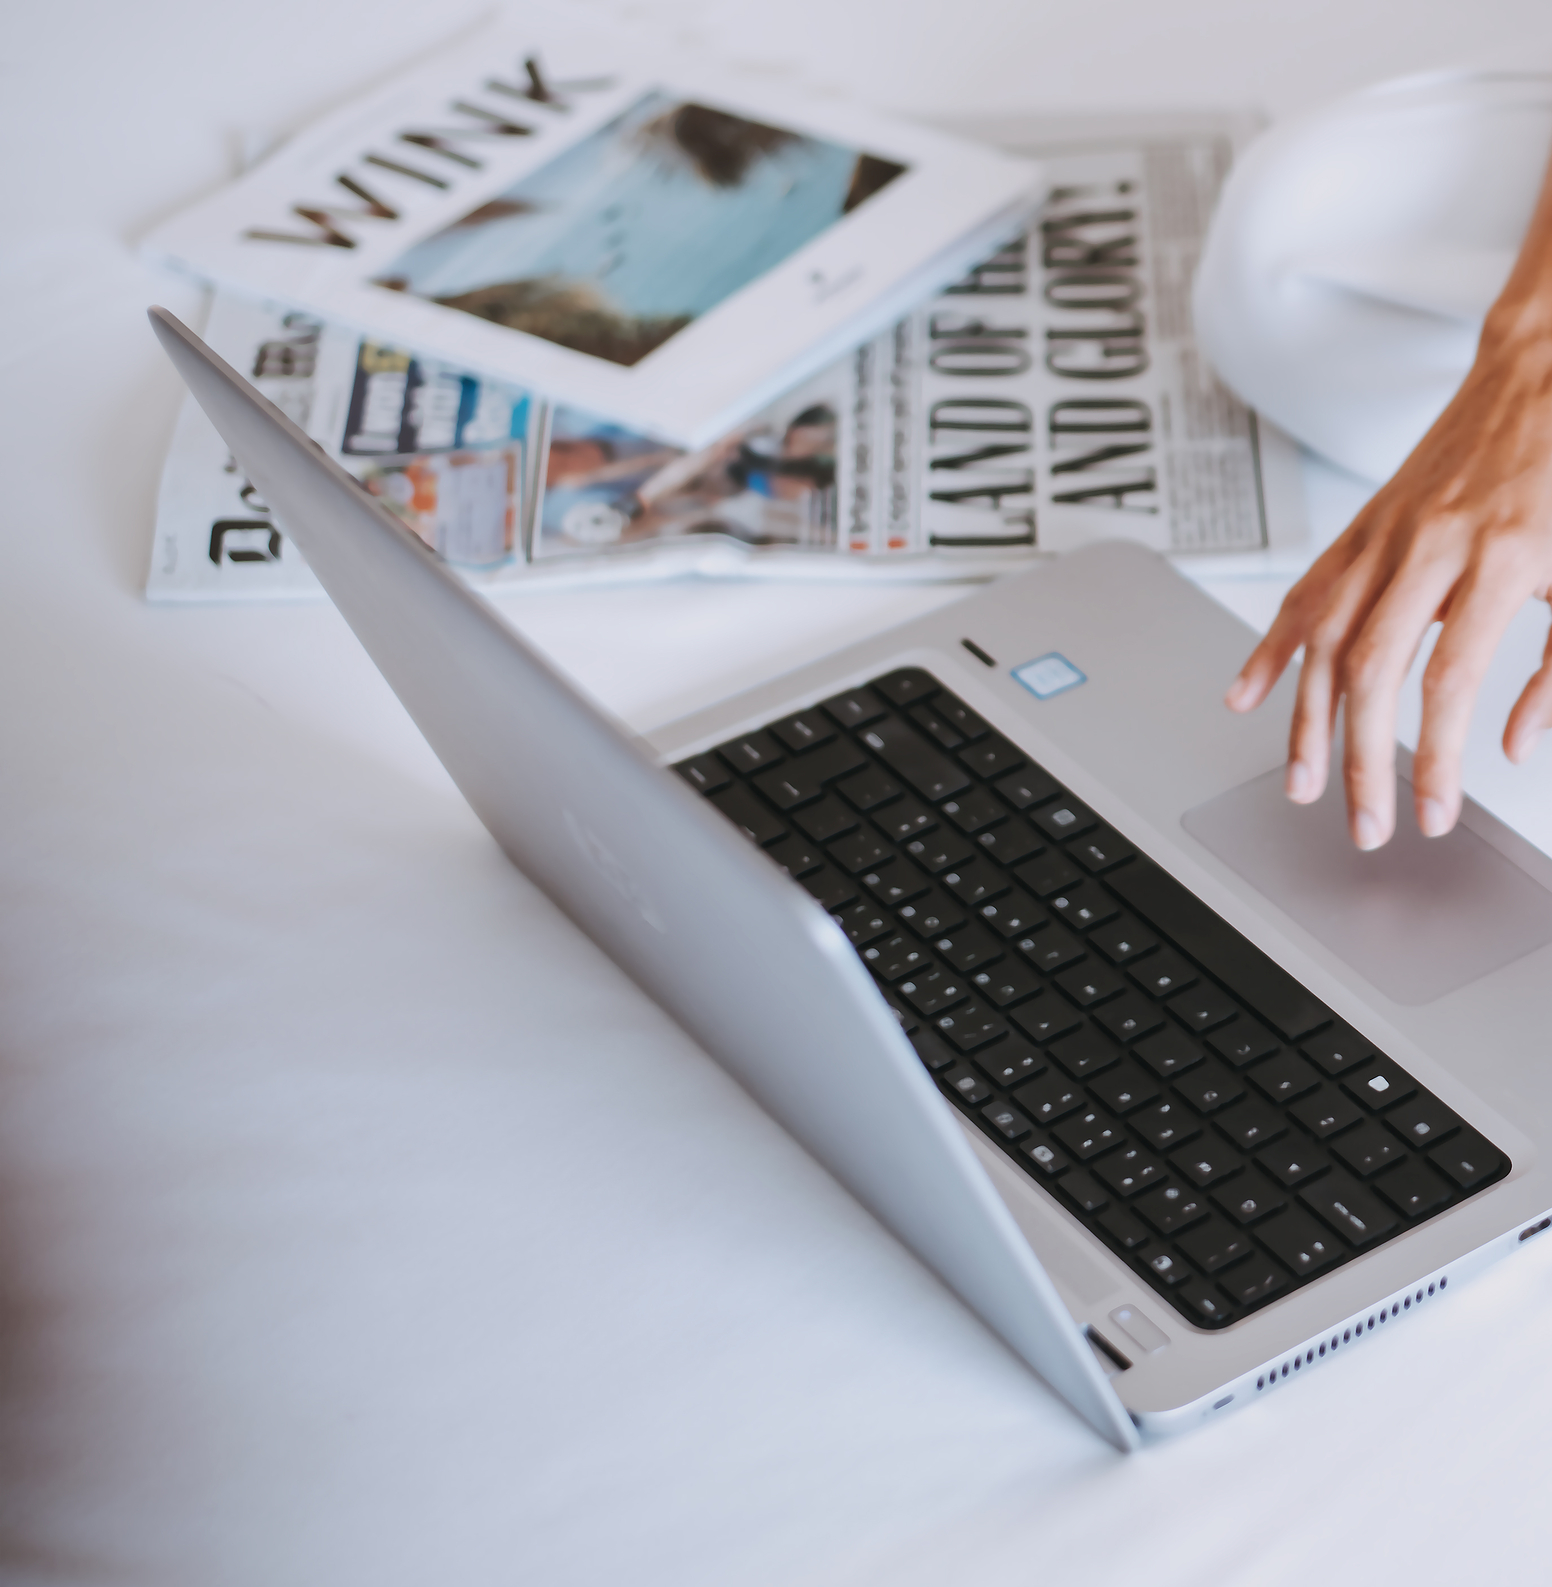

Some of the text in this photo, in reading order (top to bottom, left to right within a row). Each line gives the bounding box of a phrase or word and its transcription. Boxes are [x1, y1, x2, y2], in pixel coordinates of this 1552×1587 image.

[242, 54, 614, 251] WINK
[929, 312, 1033, 378] OF
[929, 397, 1037, 547] LAND
[1048, 397, 1160, 516] AND
